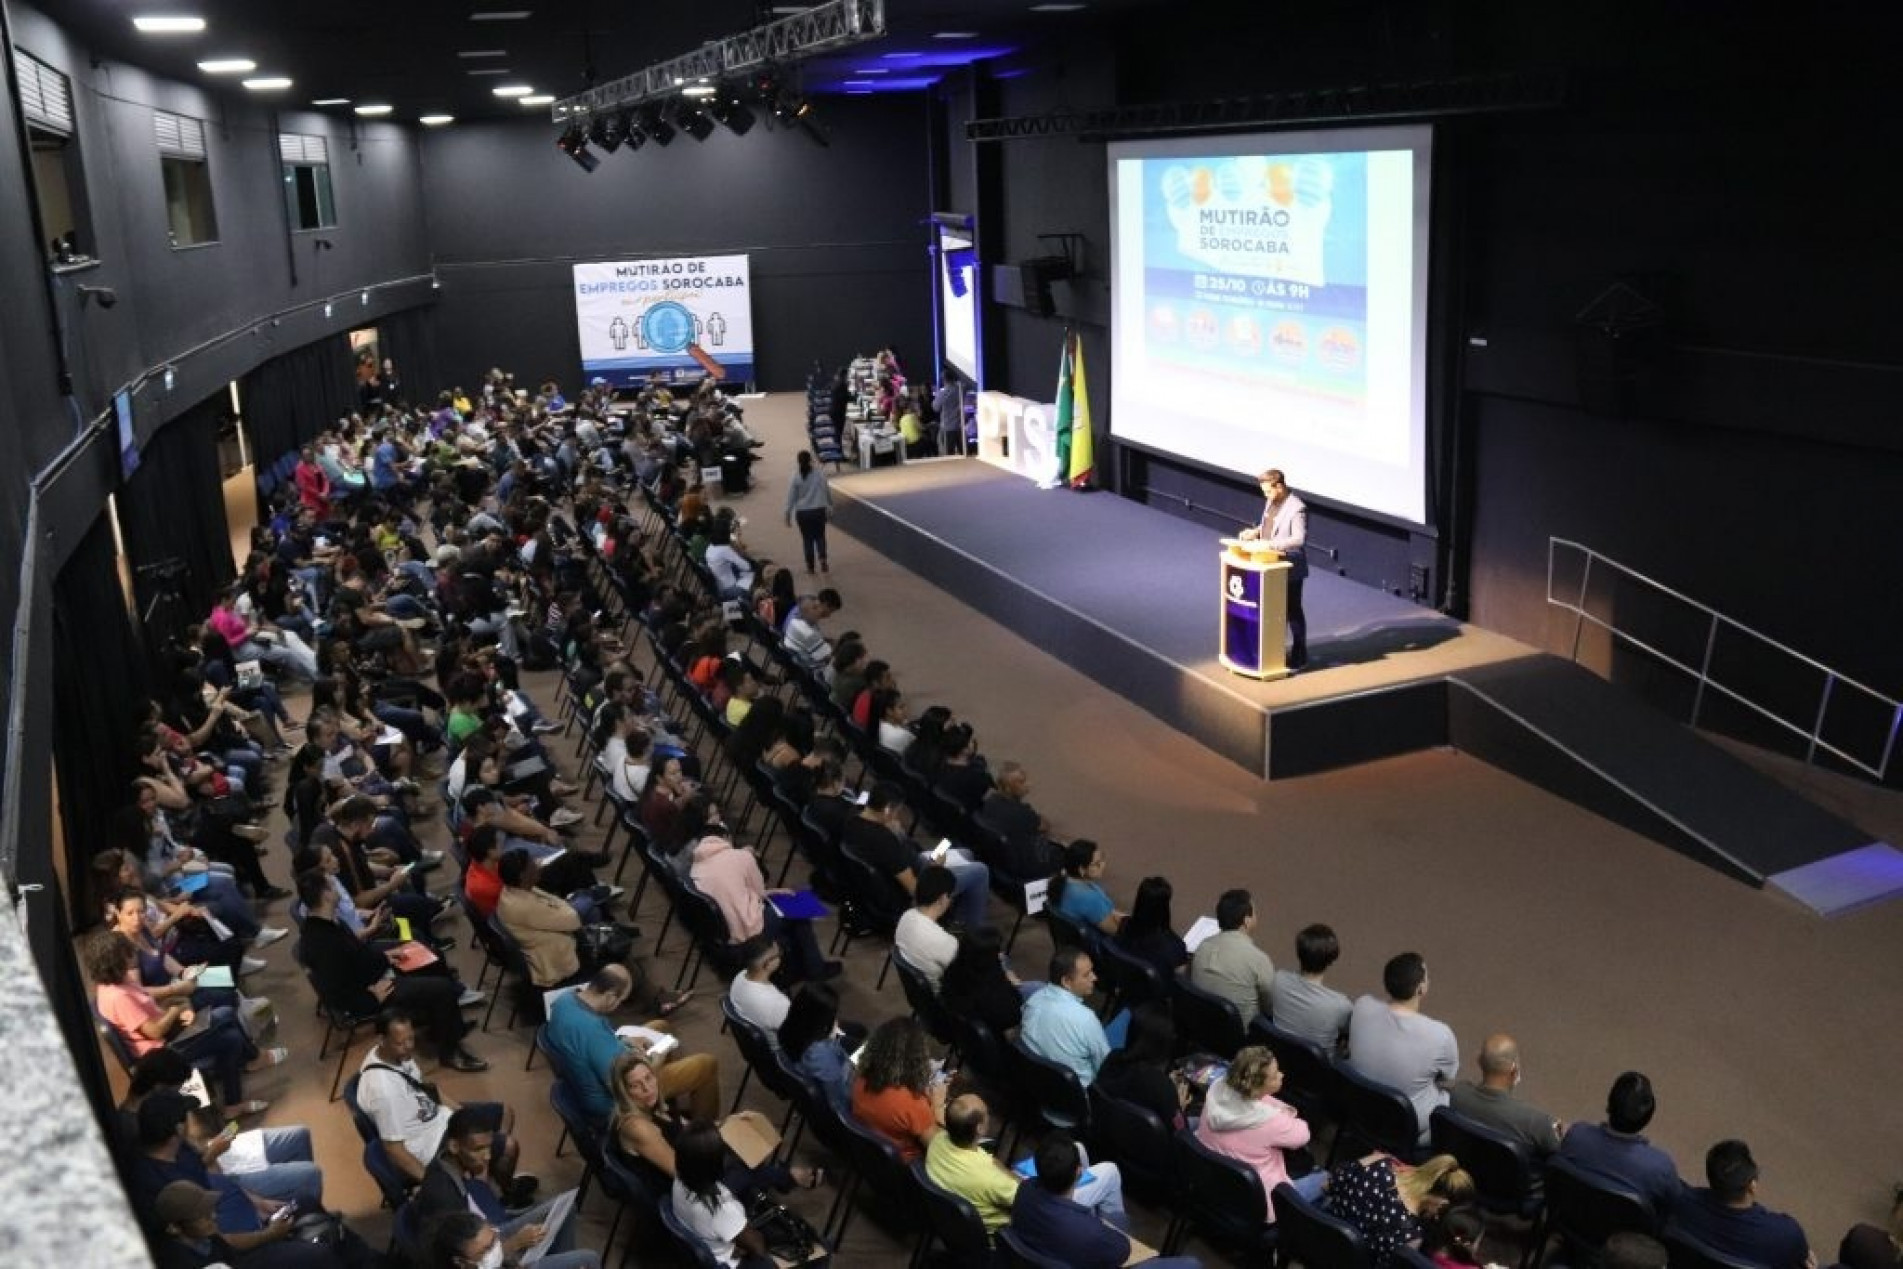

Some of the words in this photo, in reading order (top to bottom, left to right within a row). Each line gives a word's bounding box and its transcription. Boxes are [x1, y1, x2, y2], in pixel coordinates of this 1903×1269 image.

[1199, 206, 1290, 227] MUTIRÃO
[1199, 225, 1215, 236] DE
[1199, 237, 1290, 254] SOROCABA
[687, 261, 706, 274] DE
[579, 279, 658, 294] EMPREGOS
[662, 276, 745, 291] SOROCABA
[977, 391, 1052, 480] PTS
